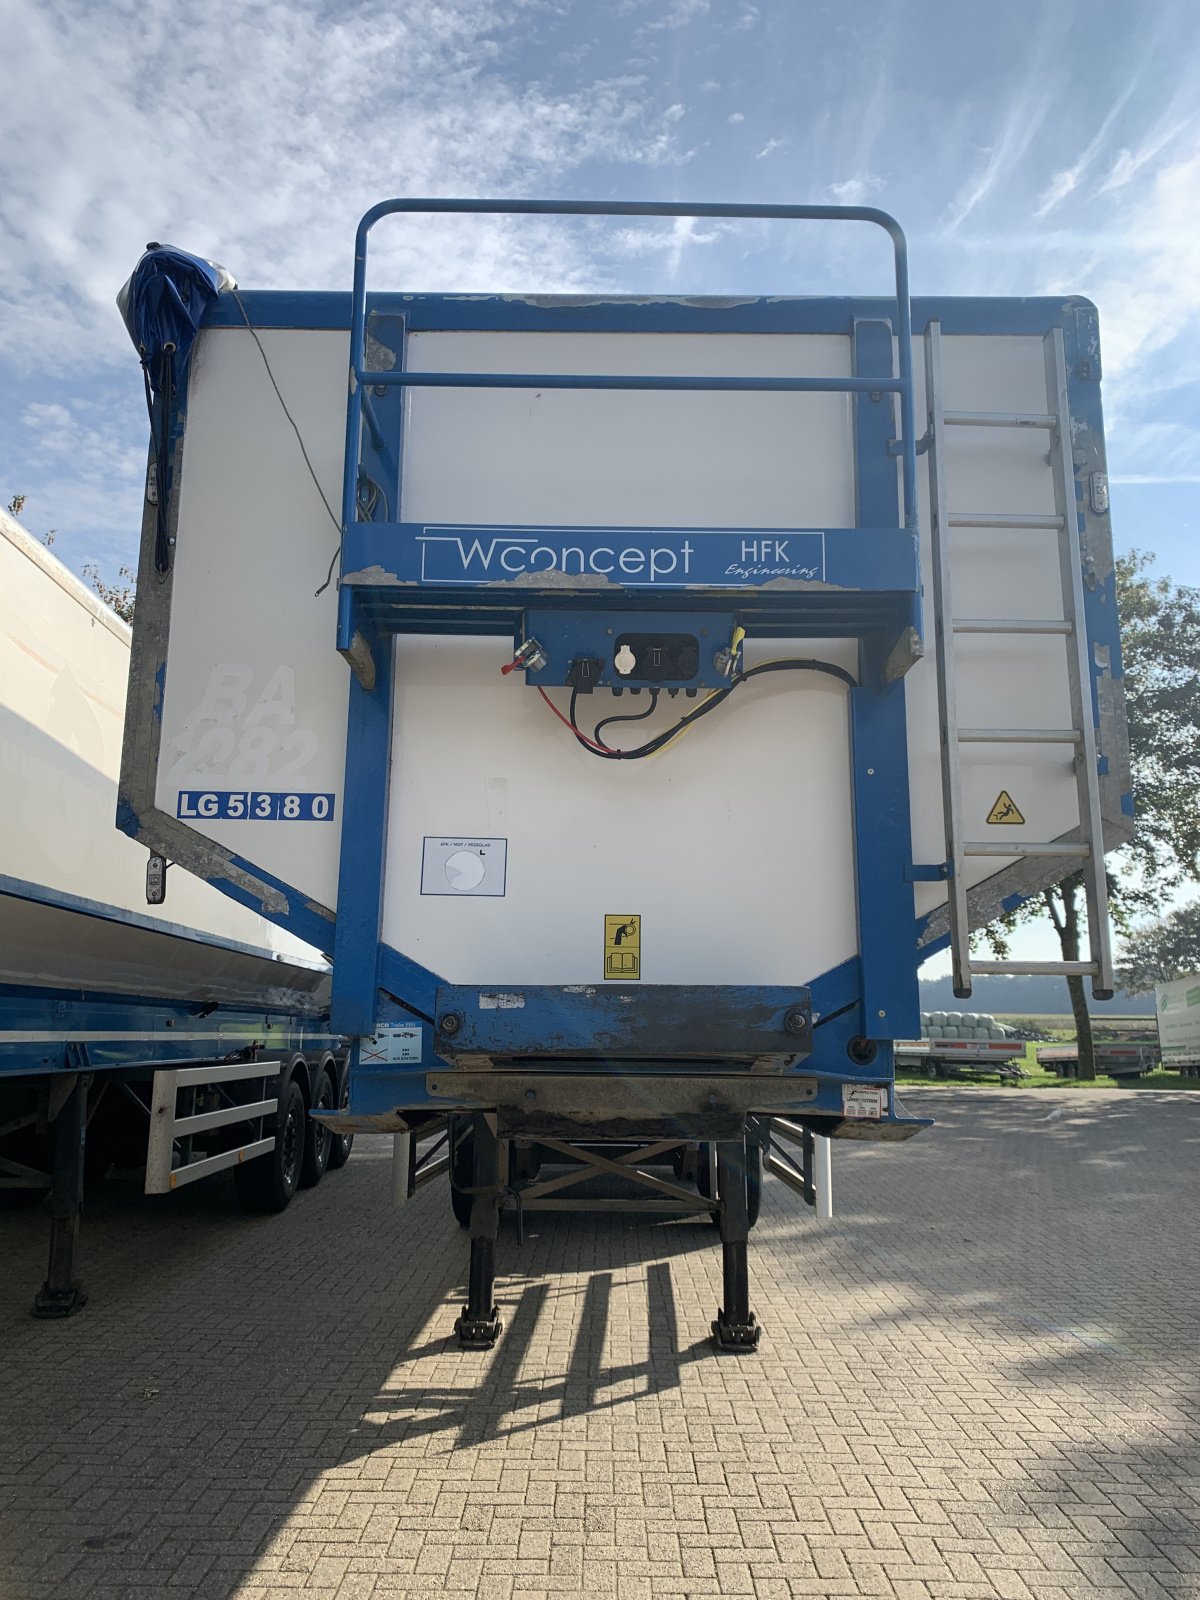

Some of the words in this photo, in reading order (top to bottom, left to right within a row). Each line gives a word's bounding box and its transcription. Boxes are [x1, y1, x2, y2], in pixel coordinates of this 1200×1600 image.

[455, 537, 694, 582] Wconcept
[741, 540, 790, 562] HFK
[724, 563, 819, 578] Engineering
